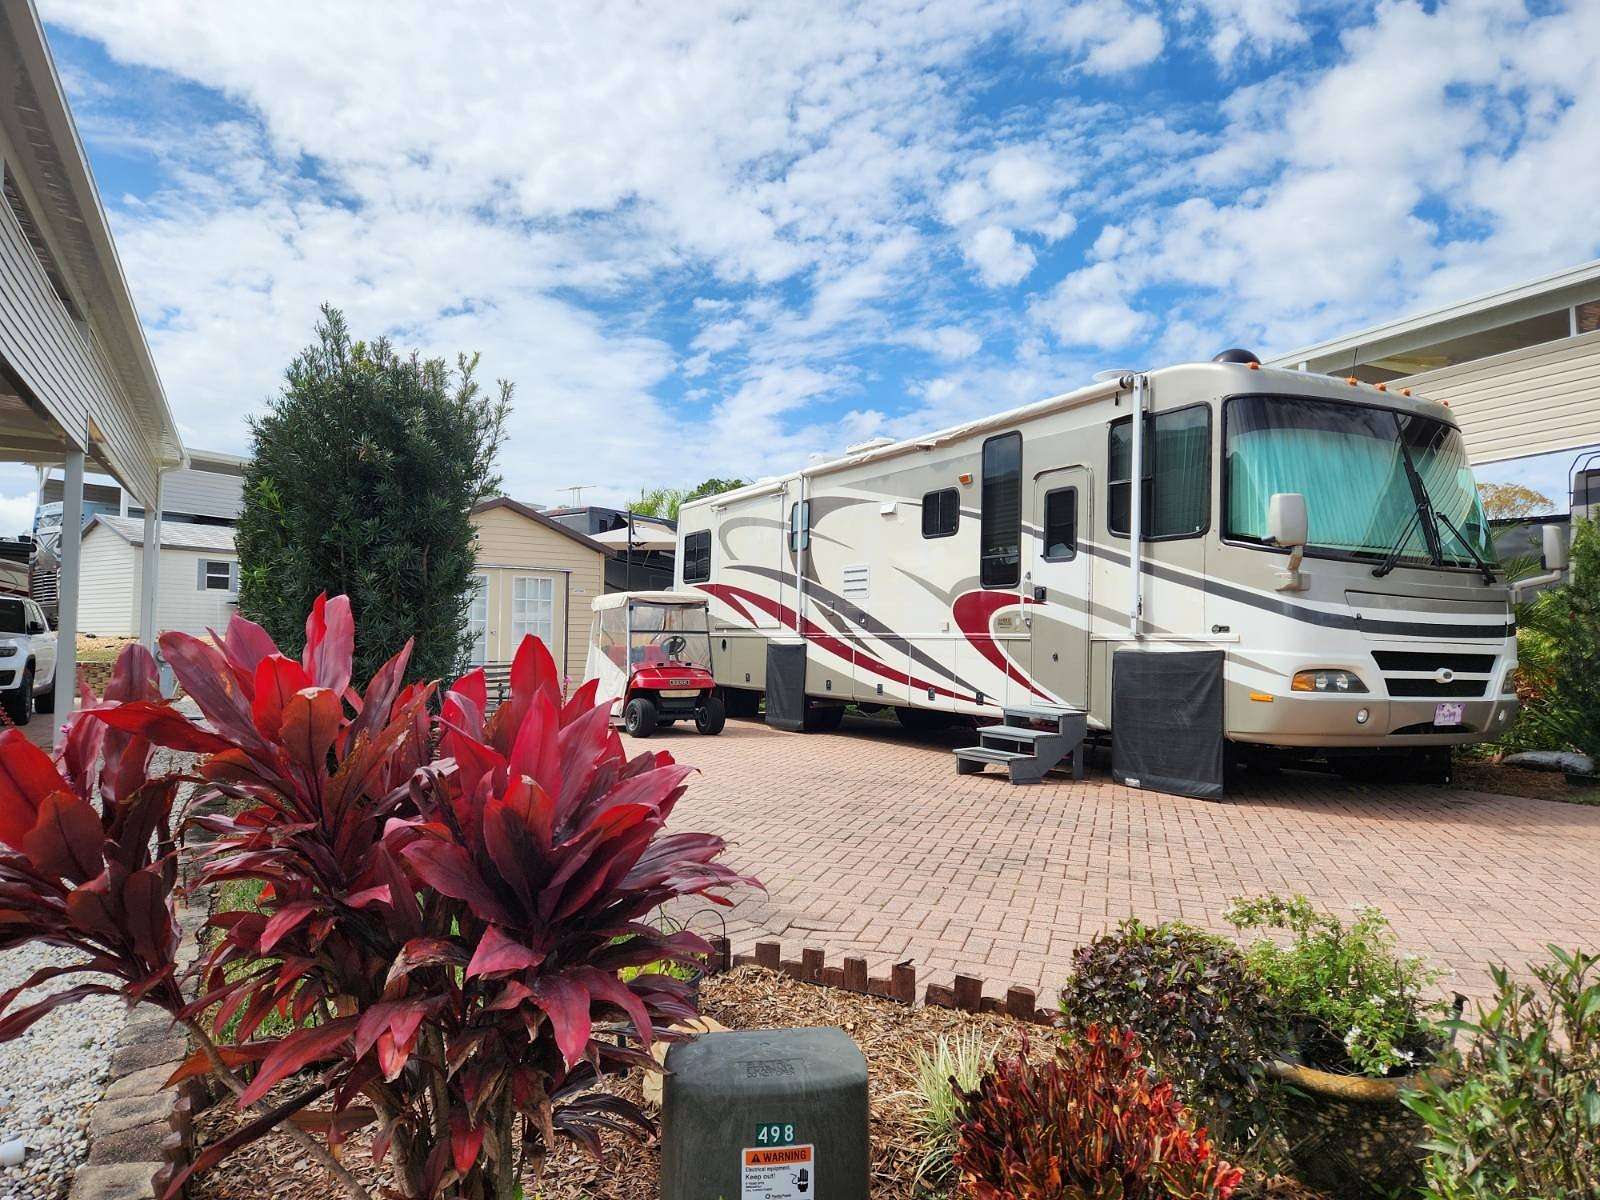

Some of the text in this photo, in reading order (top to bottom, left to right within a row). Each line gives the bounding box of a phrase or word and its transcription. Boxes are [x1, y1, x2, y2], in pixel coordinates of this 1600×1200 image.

[757, 1124, 794, 1144] 498
[763, 1150, 807, 1163] WARNING
[763, 1172, 776, 1180] out!
